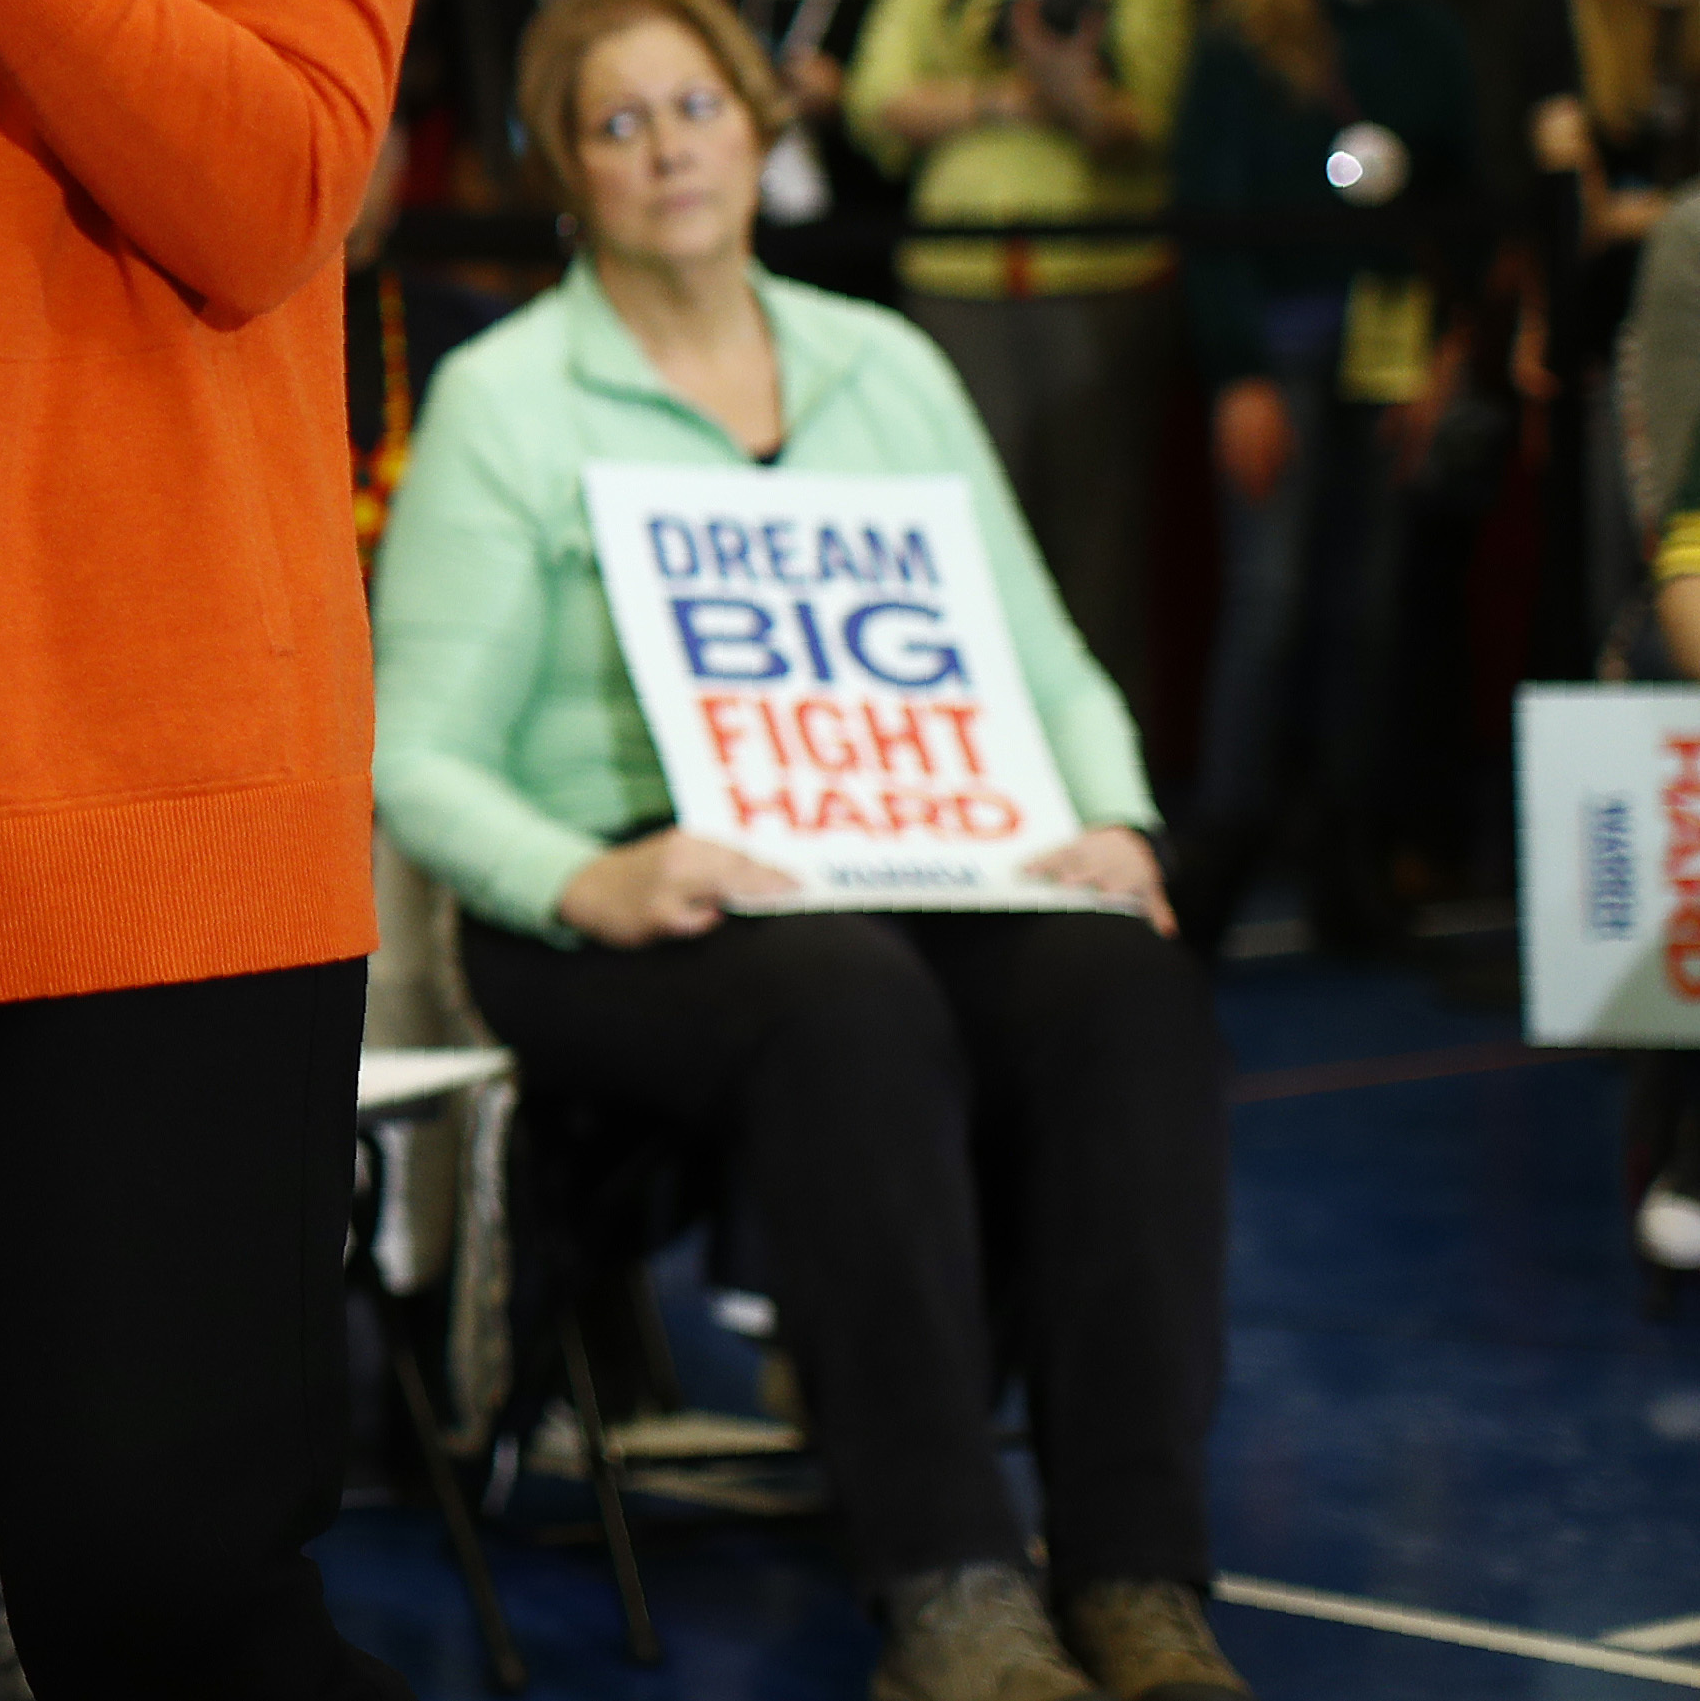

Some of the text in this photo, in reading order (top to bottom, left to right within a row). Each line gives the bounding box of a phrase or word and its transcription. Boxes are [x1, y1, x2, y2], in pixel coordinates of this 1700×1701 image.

[646, 514, 940, 586] DREAM
[670, 595, 973, 687] BIG
[699, 695, 984, 777] FIGHT
[726, 782, 1025, 840] HARD
